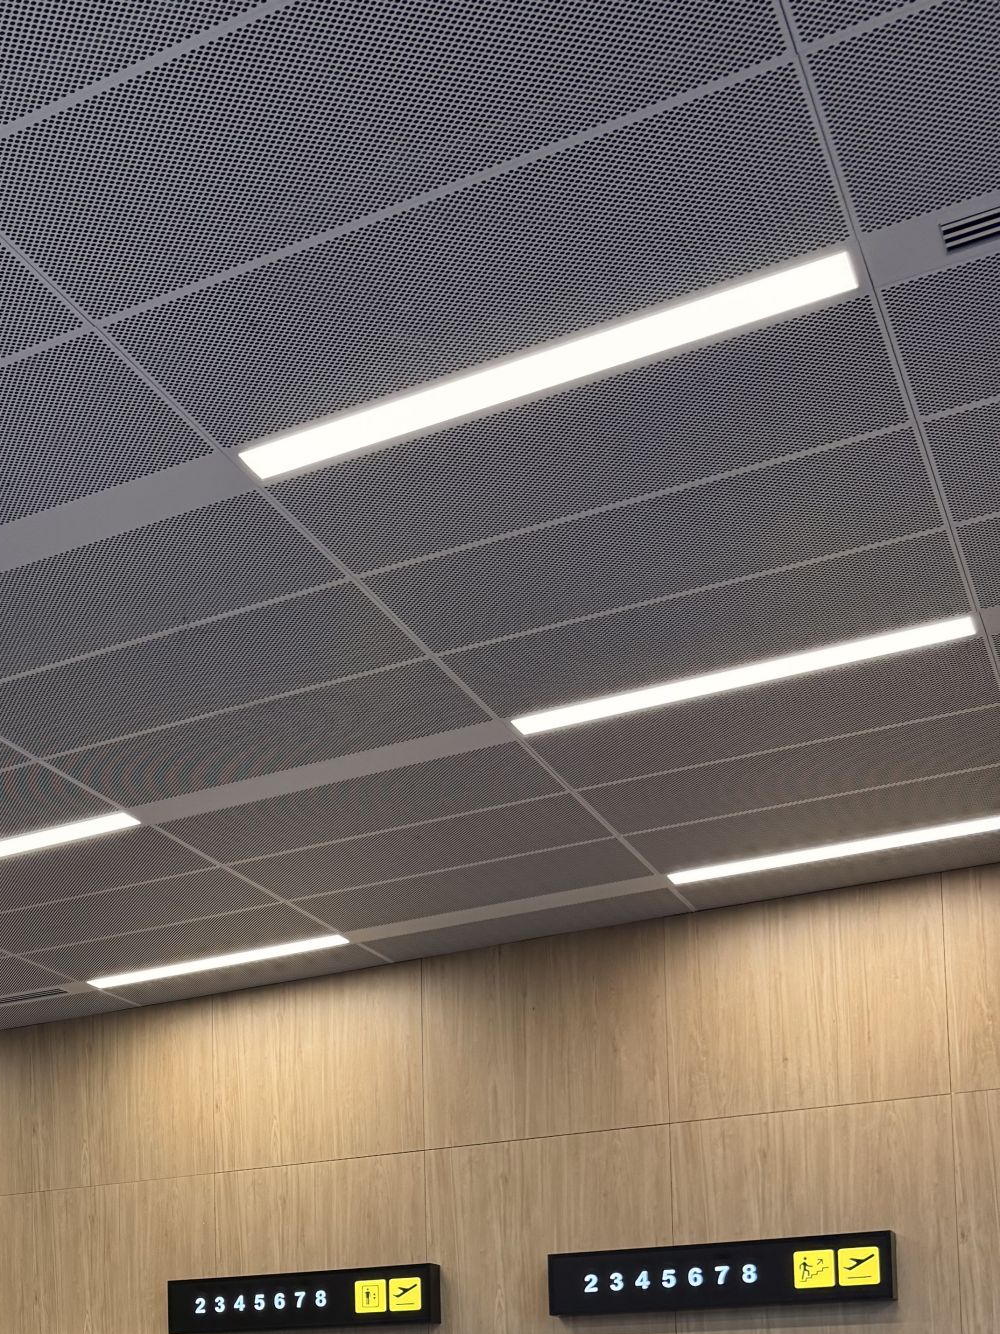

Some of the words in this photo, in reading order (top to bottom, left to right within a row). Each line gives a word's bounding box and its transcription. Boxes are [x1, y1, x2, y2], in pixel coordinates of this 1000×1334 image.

[583, 1273, 599, 1293] 2
[609, 1272, 625, 1292] 3
[634, 1270, 651, 1290] 4
[661, 1268, 677, 1289] 5
[687, 1266, 704, 1287] 6
[714, 1265, 730, 1285] 7
[741, 1263, 758, 1284] 8
[194, 1297, 207, 1314] 2
[214, 1295, 226, 1313] 3
[233, 1294, 246, 1312] 4
[253, 1293, 266, 1311] 5
[273, 1292, 286, 1310] 6
[293, 1290, 306, 1309] 7
[314, 1289, 327, 1308] 8
